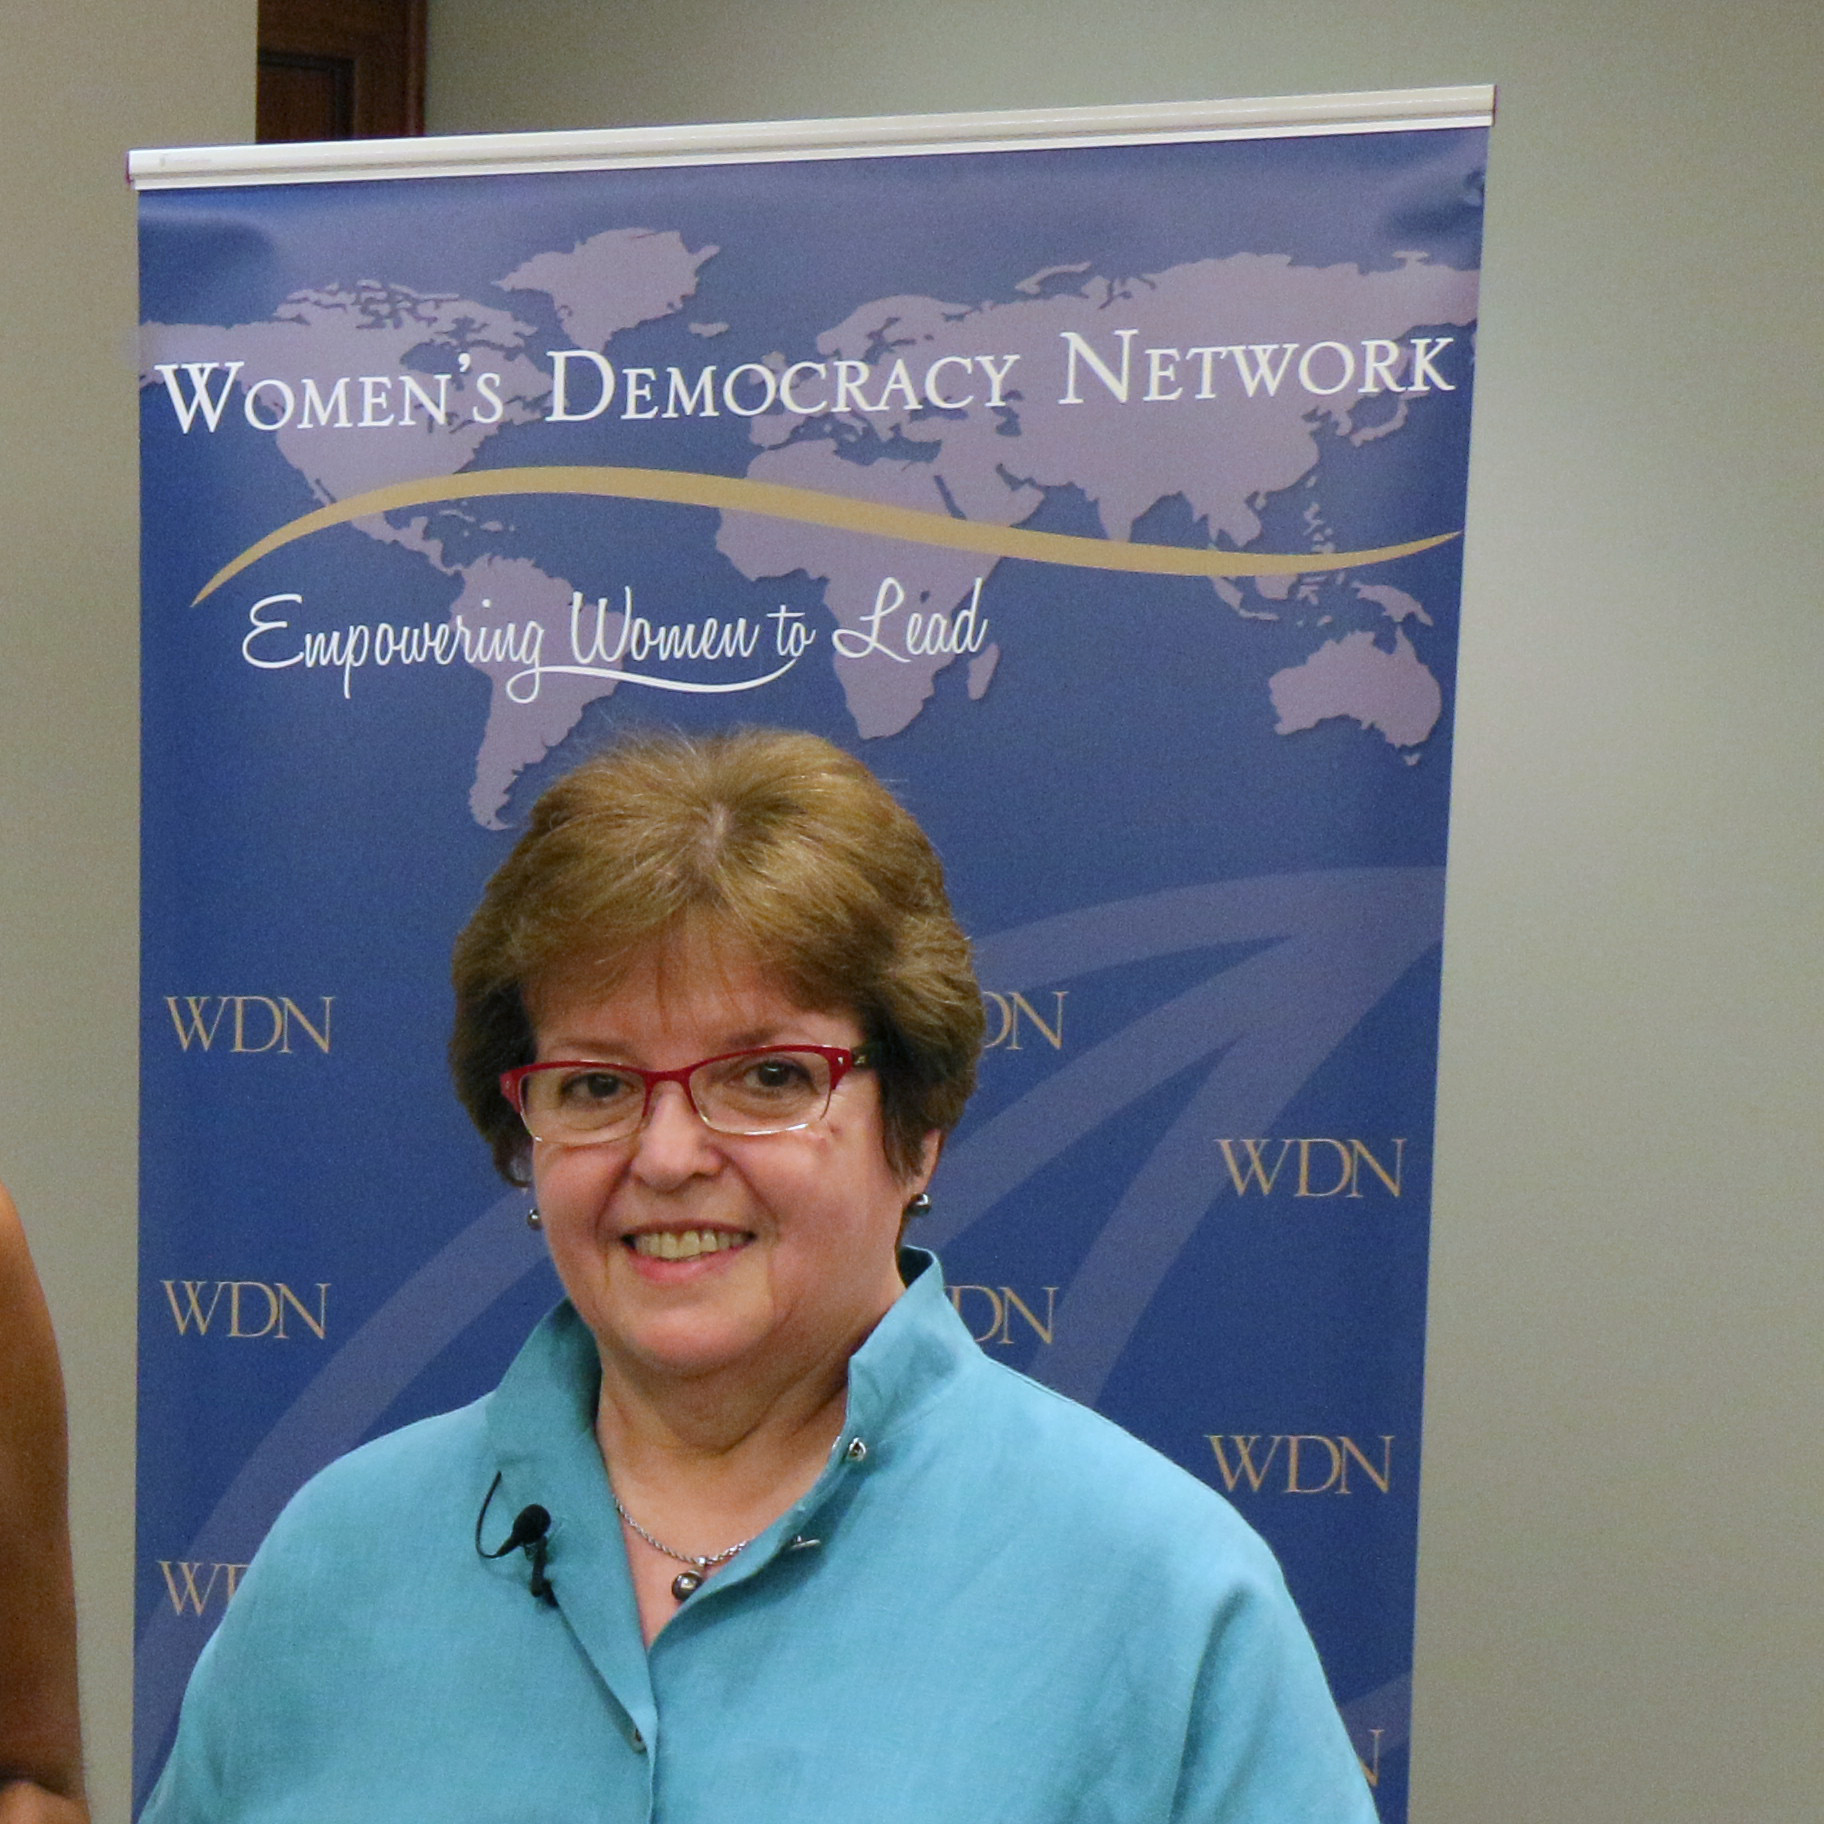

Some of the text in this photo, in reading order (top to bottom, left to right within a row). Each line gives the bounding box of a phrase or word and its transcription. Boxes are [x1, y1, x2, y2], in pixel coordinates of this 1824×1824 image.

[545, 349, 1022, 422] DEMOCRACY
[1058, 328, 1456, 405] NETWORK
[242, 577, 989, 704] Empowering Women to Lead
[163, 995, 337, 1055] WDN
[981, 990, 1070, 1050] DN
[1216, 1137, 1408, 1199] WDN
[160, 1279, 332, 1341] WDN
[944, 1284, 1060, 1345] DN
[1205, 1433, 1396, 1495] WDN
